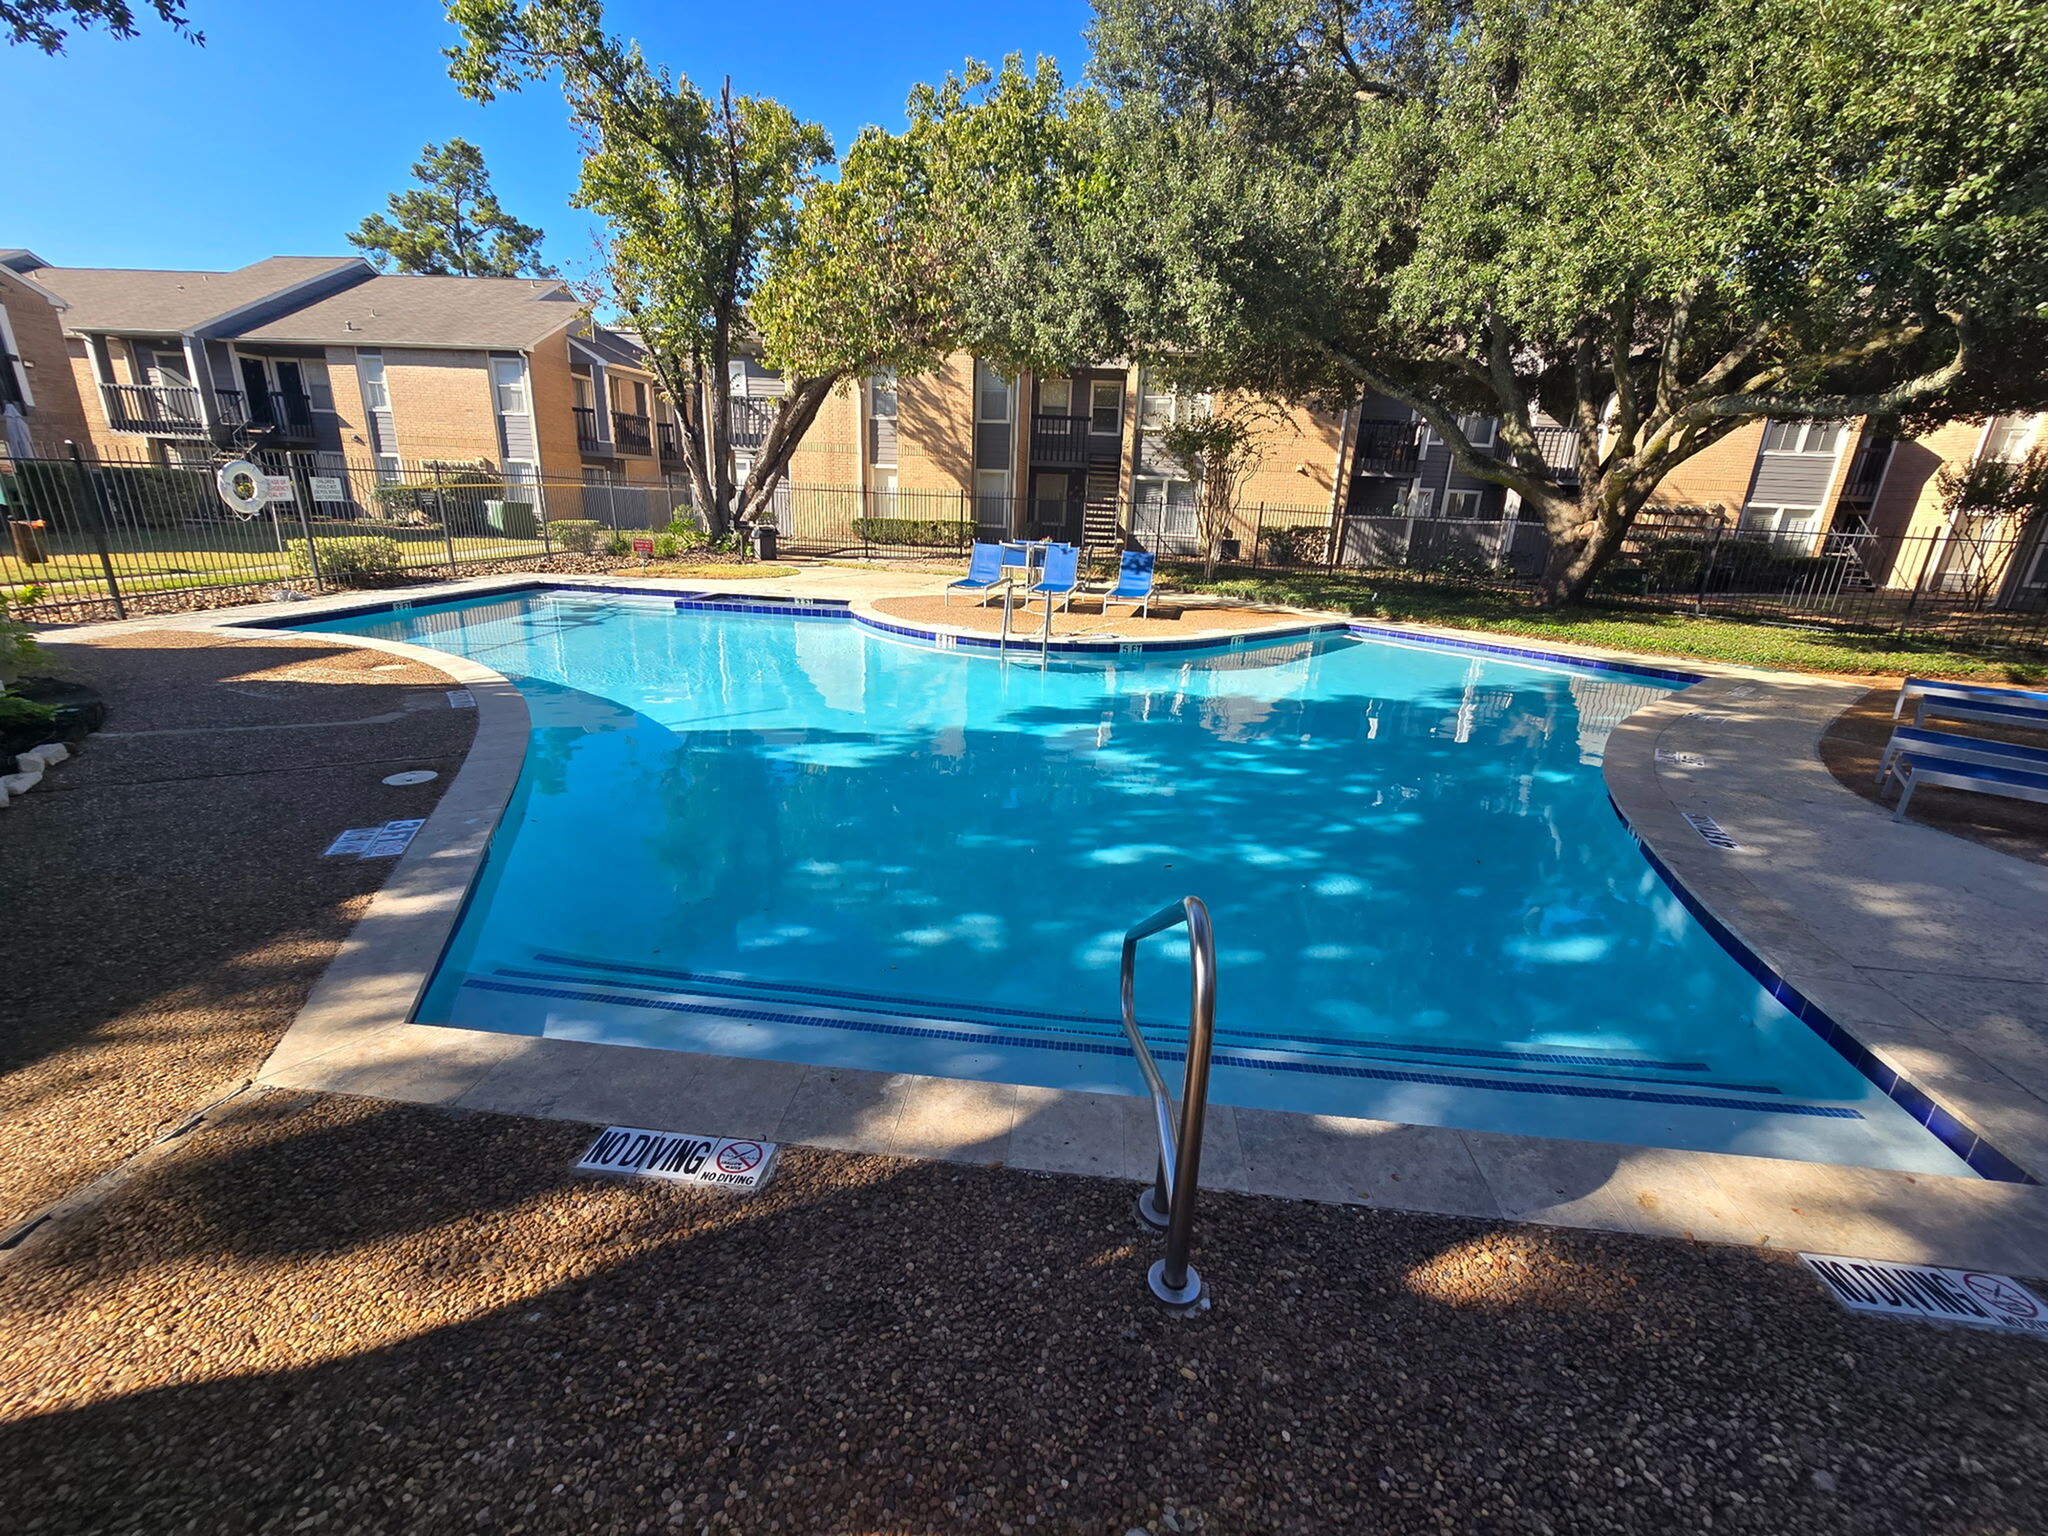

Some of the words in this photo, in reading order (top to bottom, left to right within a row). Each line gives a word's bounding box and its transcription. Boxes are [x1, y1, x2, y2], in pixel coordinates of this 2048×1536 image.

[584, 1131, 630, 1165] NO
[619, 1134, 712, 1175] DIVING
[700, 1171, 717, 1182] NO
[716, 1173, 754, 1185] DIVING
[1810, 1260, 1878, 1305] NO
[1849, 1263, 1990, 1318] DIVING
